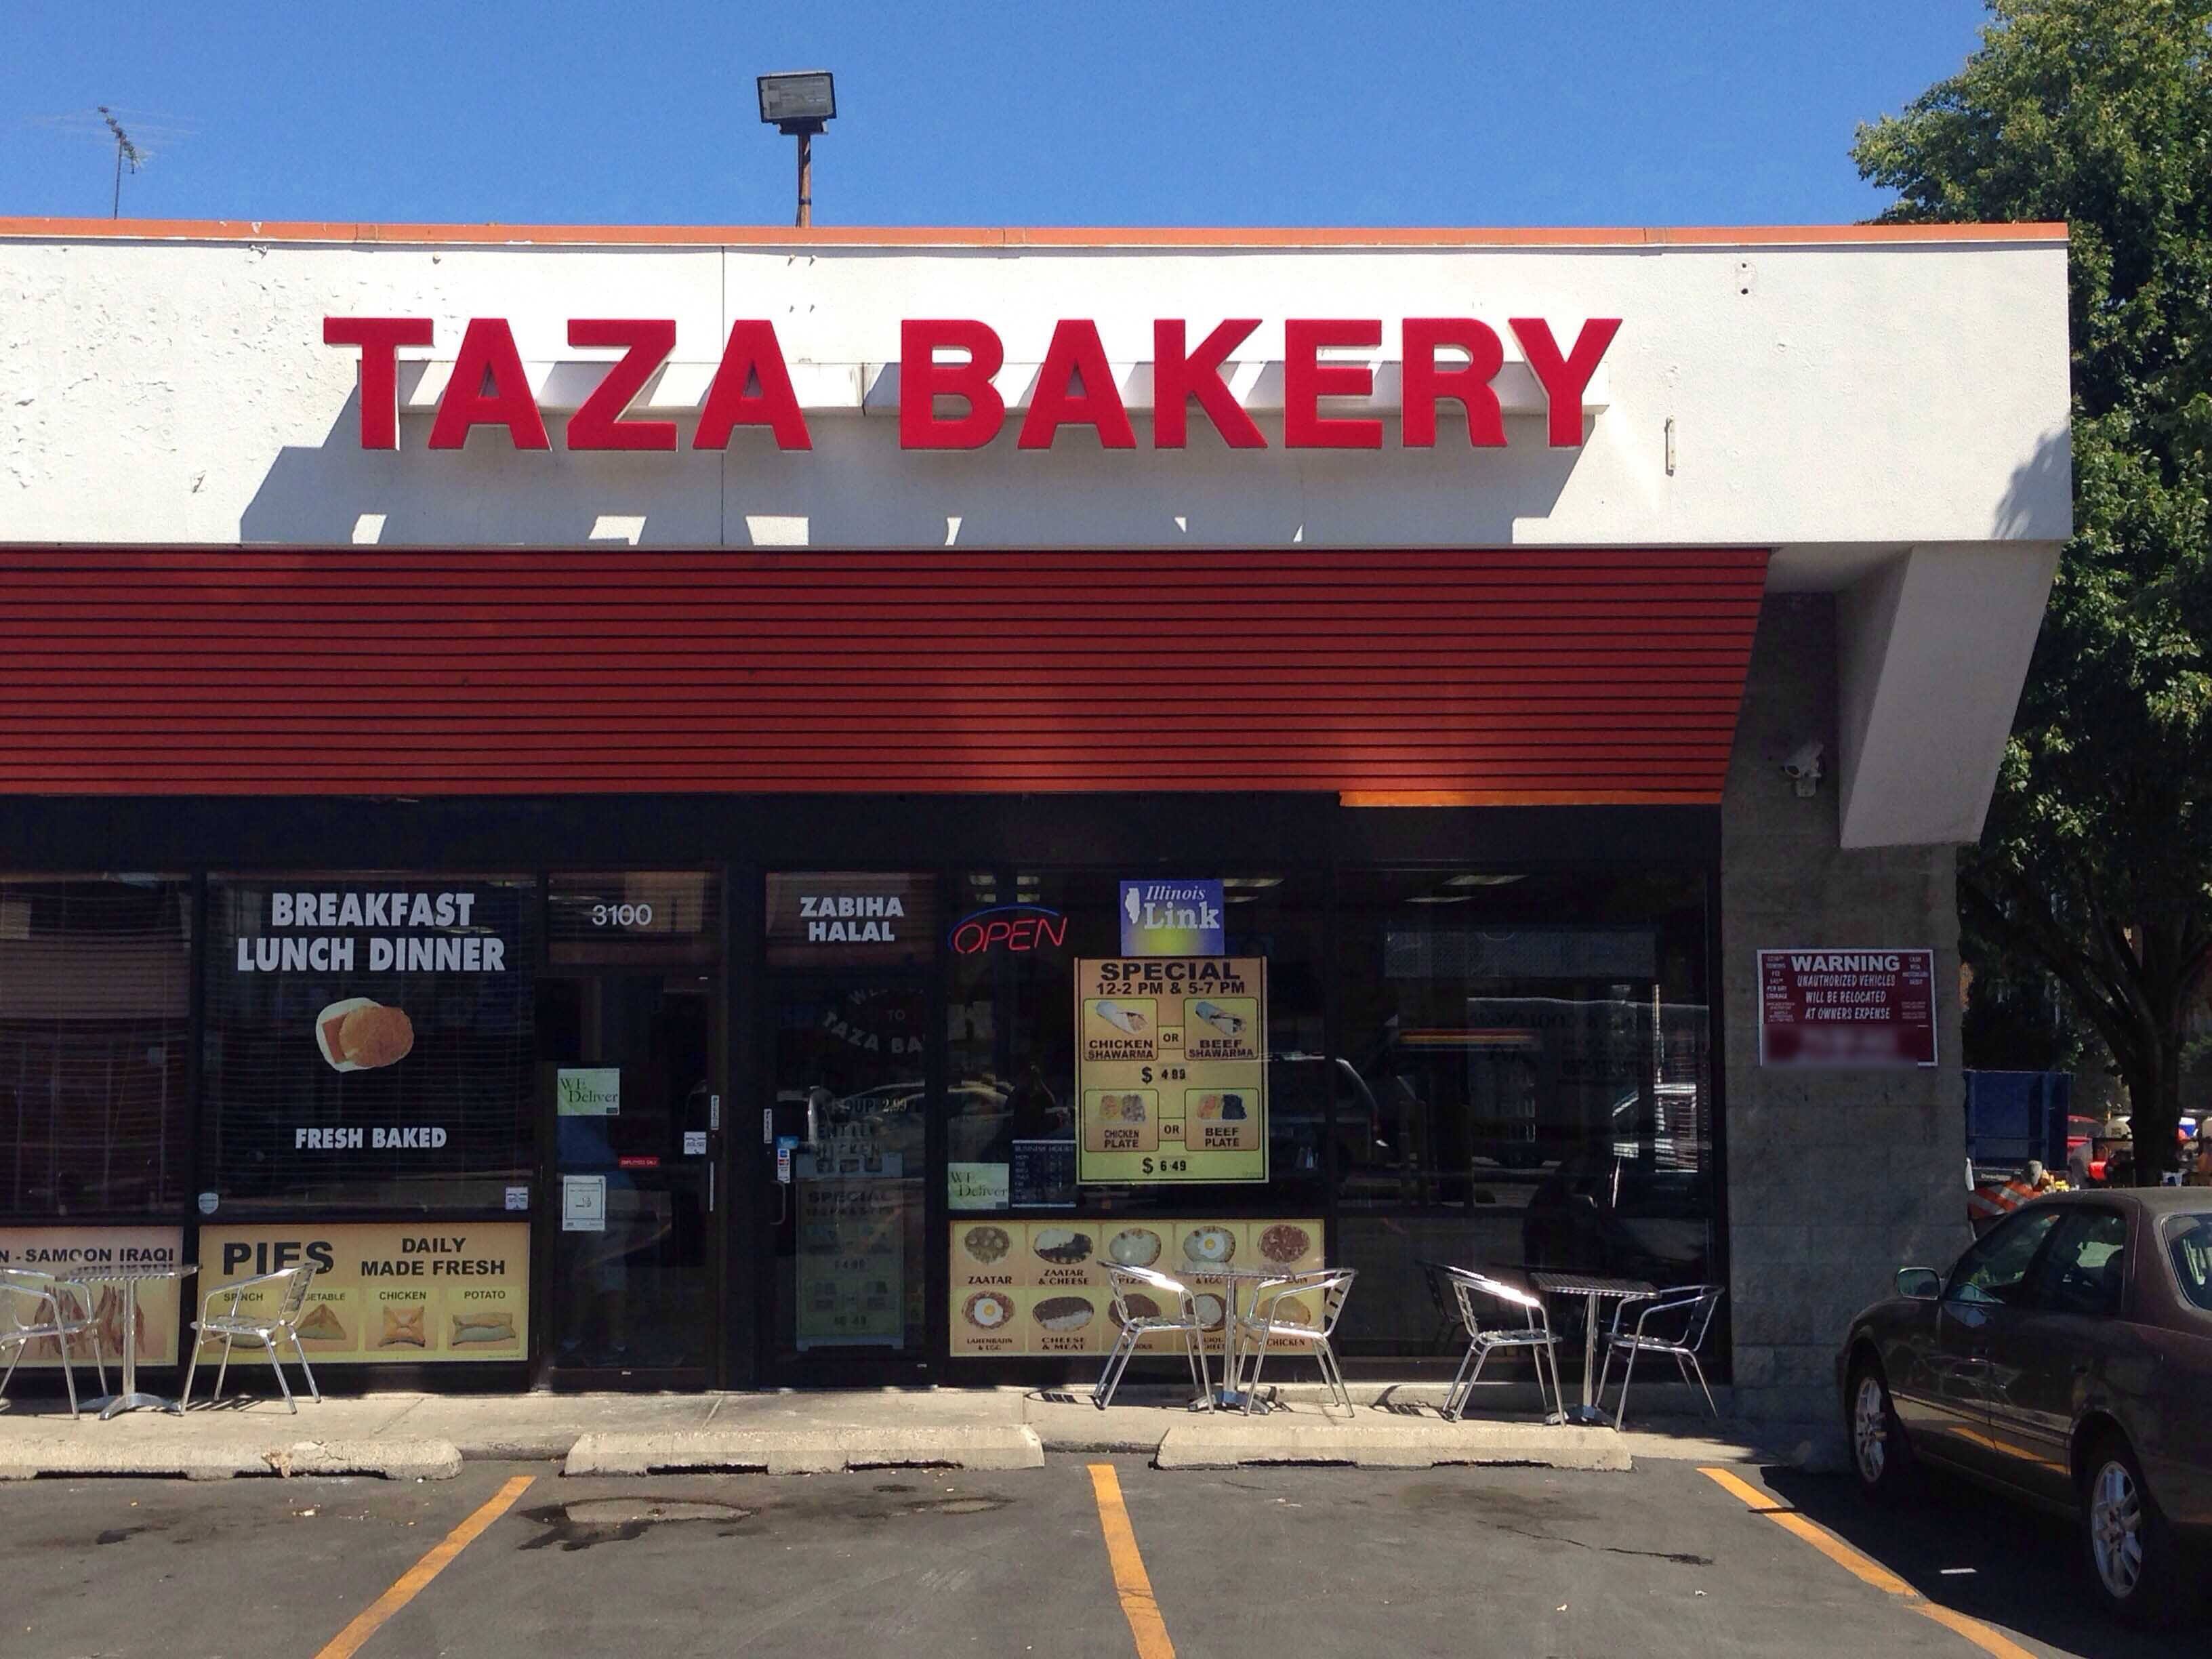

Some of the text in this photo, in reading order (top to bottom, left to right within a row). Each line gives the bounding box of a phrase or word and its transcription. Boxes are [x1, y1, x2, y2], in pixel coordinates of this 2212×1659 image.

[323, 317, 1623, 450] TAZA BAKERY
[1145, 885, 1206, 901] Illinois
[272, 892, 474, 926] BREAKFAST
[800, 897, 904, 916] ZABIHA
[592, 904, 653, 926] 3100
[1143, 901, 1221, 929] Link
[808, 921, 895, 941] HALAL
[954, 916, 1068, 954] OPEN
[237, 937, 505, 971] LUNCH DINNER
[1790, 956, 1900, 972] WARNING
[1101, 962, 1240, 981] SPECIAL
[1797, 975, 1858, 987] UNAUTHORIZED
[1859, 975, 1896, 987] VEHICLES
[1097, 981, 1245, 995] 12-2 PM & 5-7 PM
[1805, 990, 1886, 1003] WILL BE RELOCATED
[1805, 1008, 1817, 1020] AT
[1818, 1008, 1852, 1020] OWNERS
[1854, 1008, 1891, 1020] EXPENSE
[1163, 1033, 1179, 1042] OR
[1200, 1039, 1242, 1048] BEEF
[1089, 1040, 1153, 1049] CHICKEN
[1088, 1050, 1153, 1060] SHAWARMA
[1189, 1049, 1253, 1058] SHAWARMA
[1141, 1066, 1153, 1084] $
[569, 1090, 618, 1103] Deliver
[1104, 1129, 1139, 1138] CHICKEN
[1164, 1125, 1180, 1134] OR
[1205, 1128, 1240, 1136] BEEF
[295, 1128, 447, 1149] FRESH BAKED
[1104, 1139, 1139, 1148] PLATE
[1205, 1138, 1240, 1147] PLATE
[1142, 1157, 1153, 1174] $
[959, 1184, 1008, 1197] Deliver
[402, 1237, 466, 1253] DAILY
[119, 1248, 173, 1262] IRAQI
[224, 1240, 334, 1275] PIES
[361, 1260, 505, 1276] MADE FRESH
[1044, 1269, 1084, 1277] ZAATAR
[968, 1275, 1012, 1285] ZAATAR
[1048, 1277, 1090, 1285] CHEESE
[379, 1291, 427, 1301] CHICKEN
[464, 1290, 506, 1300] POTATO
